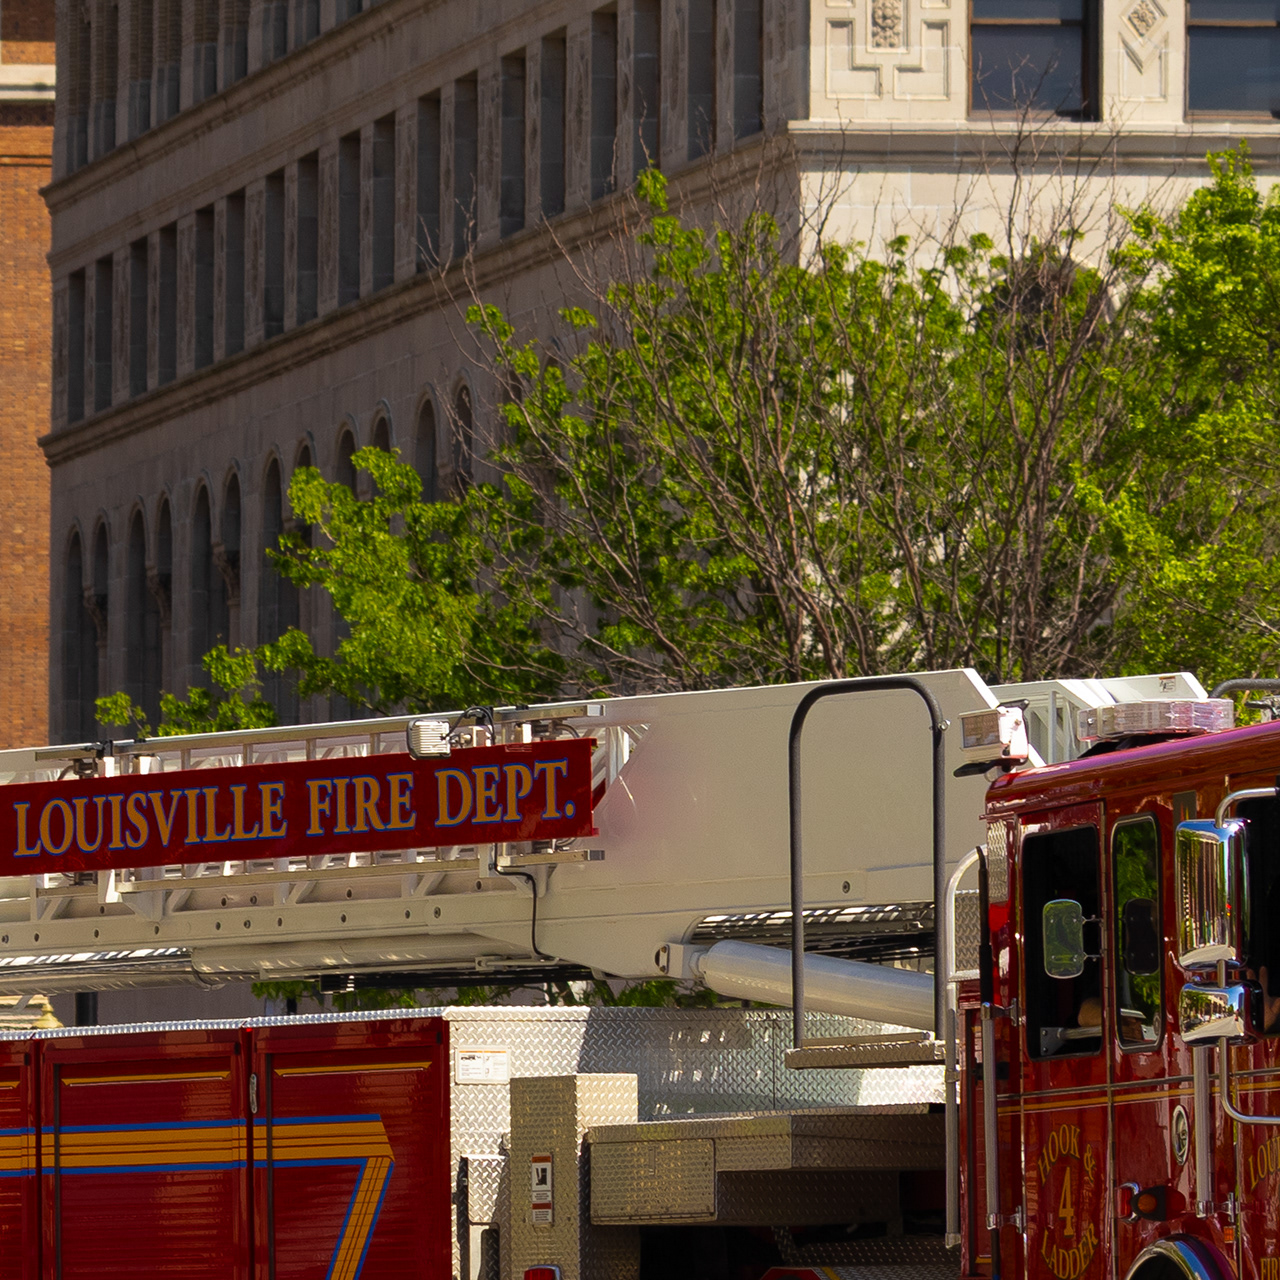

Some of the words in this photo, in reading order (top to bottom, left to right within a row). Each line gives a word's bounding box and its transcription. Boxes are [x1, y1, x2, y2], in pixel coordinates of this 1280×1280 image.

[13, 781, 287, 858] LOUISVILLE
[306, 771, 417, 837] FIRE
[434, 757, 577, 829] DEPT.
[1037, 1123, 1081, 1187] HOOK
[1083, 1143, 1097, 1182] &
[1058, 1166, 1075, 1238] 4
[1040, 1222, 1099, 1280] LADDER
